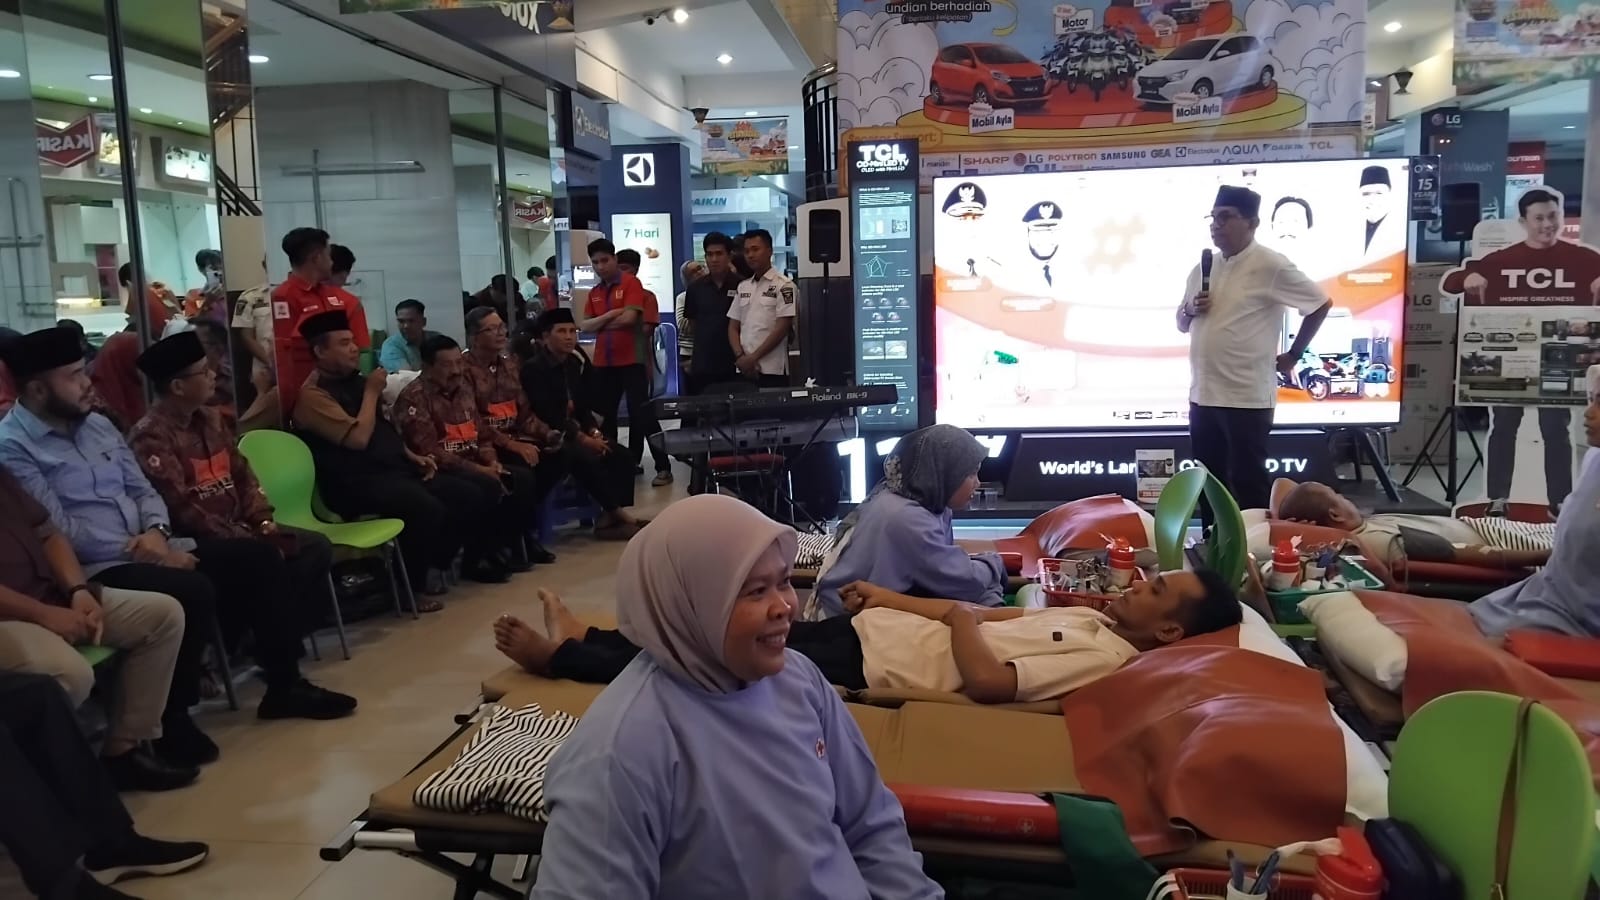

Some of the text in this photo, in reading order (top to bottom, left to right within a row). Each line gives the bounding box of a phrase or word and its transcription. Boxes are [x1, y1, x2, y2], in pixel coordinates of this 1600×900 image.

[887, 1, 991, 13] undian berhadiah
[1062, 18, 1089, 28] Motor
[1176, 103, 1220, 117] Mobil Ayla
[972, 115, 1012, 128] Mobil Ayla
[1446, 114, 1461, 124] LG
[858, 143, 907, 161] TCL
[963, 156, 1010, 166] SHARP
[1029, 154, 1044, 164] LG
[1048, 153, 1097, 161] POLYTRON
[1101, 151, 1146, 160] SAMSUNG
[1150, 149, 1172, 158] GEA
[1222, 144, 1260, 155] AQUA
[1308, 141, 1335, 150] TCL
[1417, 178, 1434, 190] 15
[694, 197, 727, 206] AIKIN
[623, 227, 660, 239] 7 Hari
[1500, 267, 1576, 289] TCL
[1413, 294, 1432, 306] LG
[811, 391, 868, 402] Roland BK-9
[1039, 460, 1104, 475] World's
[1108, 460, 1136, 474] Lar
[1281, 458, 1308, 472] TV
